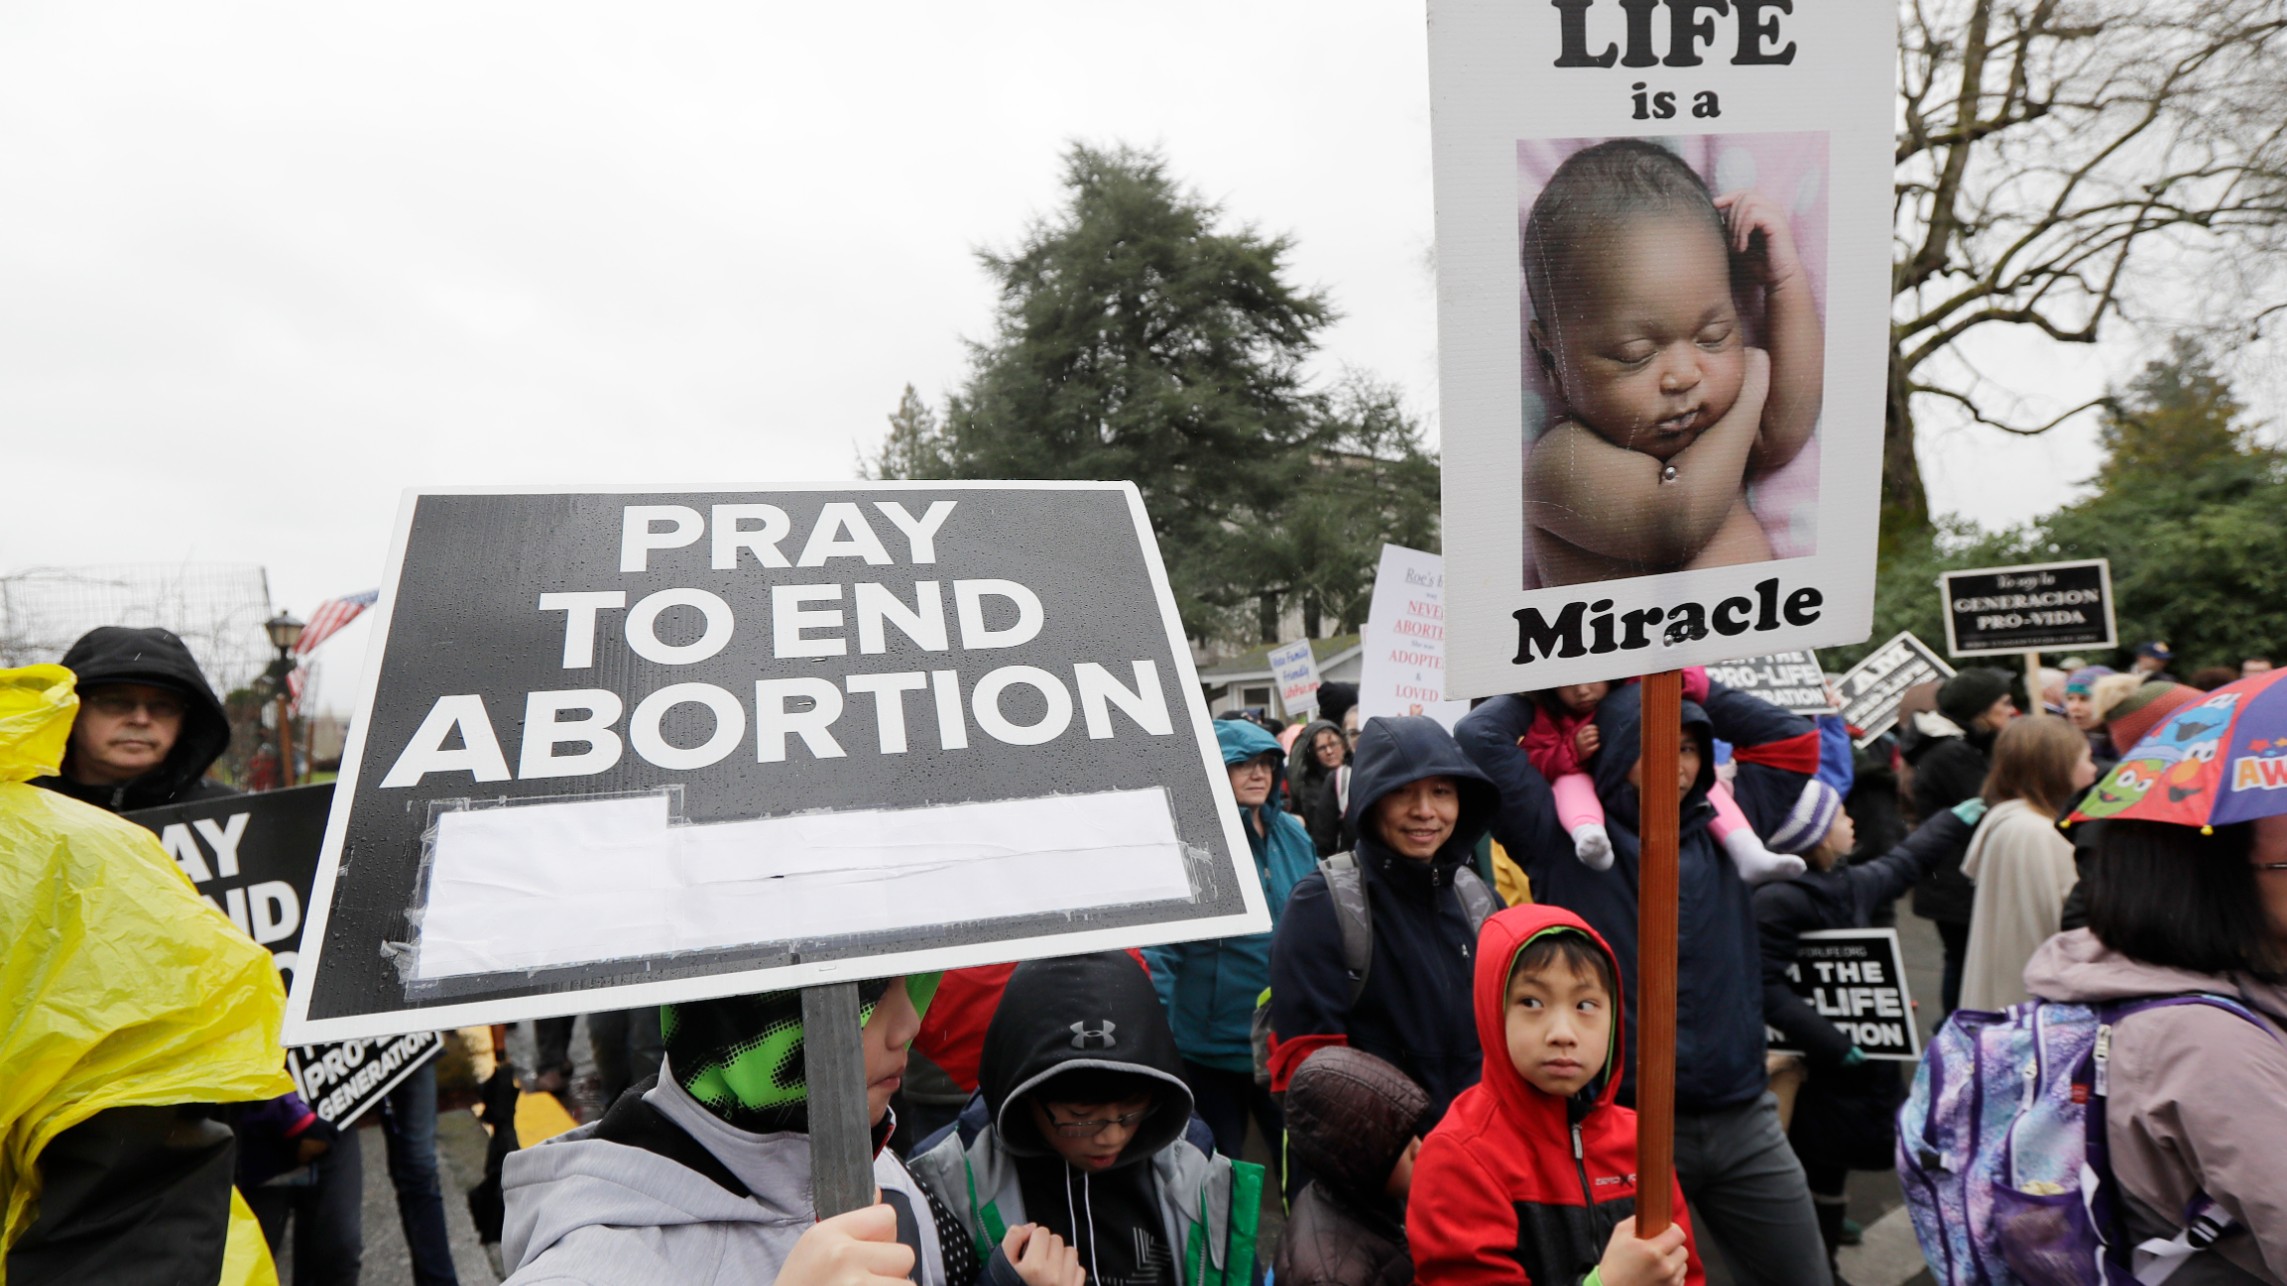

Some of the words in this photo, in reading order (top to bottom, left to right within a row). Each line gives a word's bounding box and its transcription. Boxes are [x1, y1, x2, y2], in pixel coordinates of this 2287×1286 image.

[1554, 0, 1797, 68] LIFE
[1631, 81, 1677, 119] is
[1692, 91, 1721, 118] a
[620, 500, 958, 573] PRAY
[1408, 600, 1444, 619] NEVE
[1953, 589, 2099, 613] GENERACION
[539, 587, 735, 669] TO
[772, 578, 1045, 659] END
[1394, 619, 1445, 640] ABORTE
[1512, 578, 1823, 665] Miracle
[1976, 610, 2087, 630] PRO-VIDA
[1389, 649, 1445, 670] ADOPTE
[1396, 684, 1439, 702] LOVED
[379, 660, 1174, 788] ABORTION
[161, 812, 250, 883] AY
[1813, 961, 1884, 983] THE
[1804, 987, 1903, 1017] -LIFE
[317, 1031, 433, 1122] GENERATION
